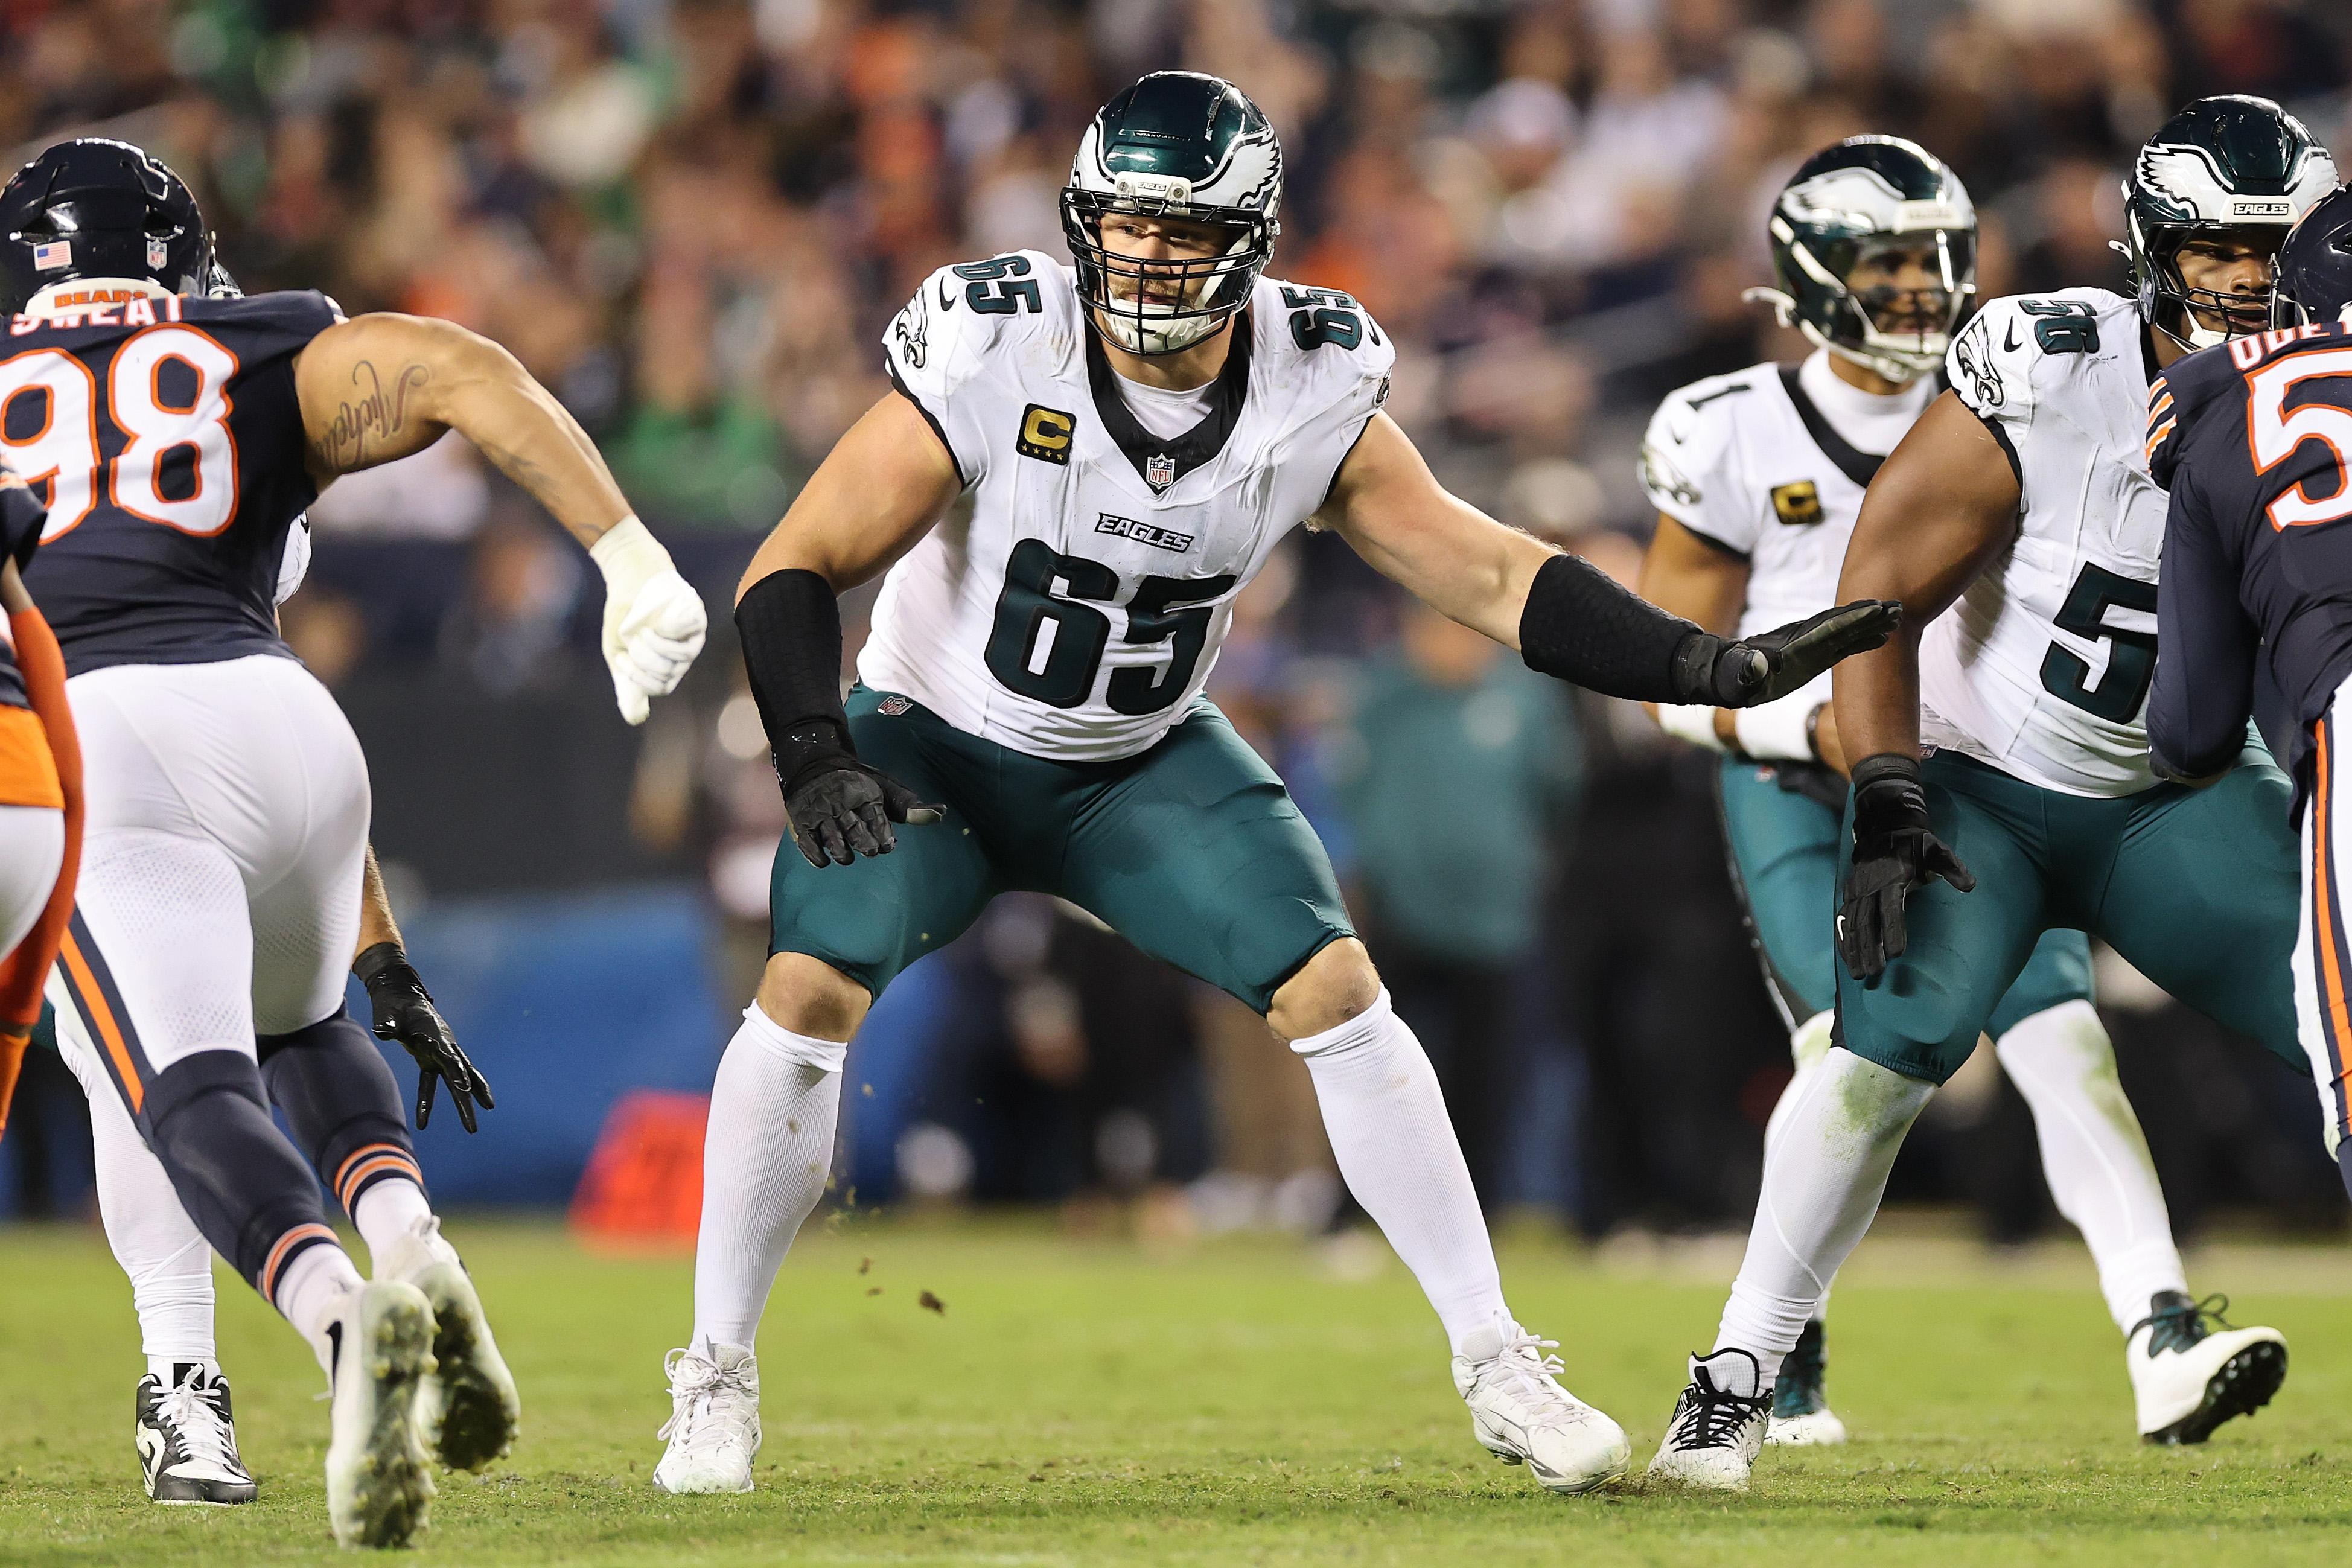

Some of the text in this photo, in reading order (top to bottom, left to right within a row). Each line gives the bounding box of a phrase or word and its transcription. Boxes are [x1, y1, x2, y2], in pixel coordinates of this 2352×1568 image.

[1137, 182, 1167, 191] EAGLES
[2233, 203, 2289, 216] EAGLES
[952, 255, 1043, 314] 65
[1279, 286, 1363, 351] 65
[2018, 299, 2101, 355] 56
[0, 322, 240, 546] 98
[1024, 409, 1071, 450] C
[1151, 469, 1170, 483] NFL
[1095, 512, 1195, 553] EAGLES
[984, 538, 1237, 716] 65
